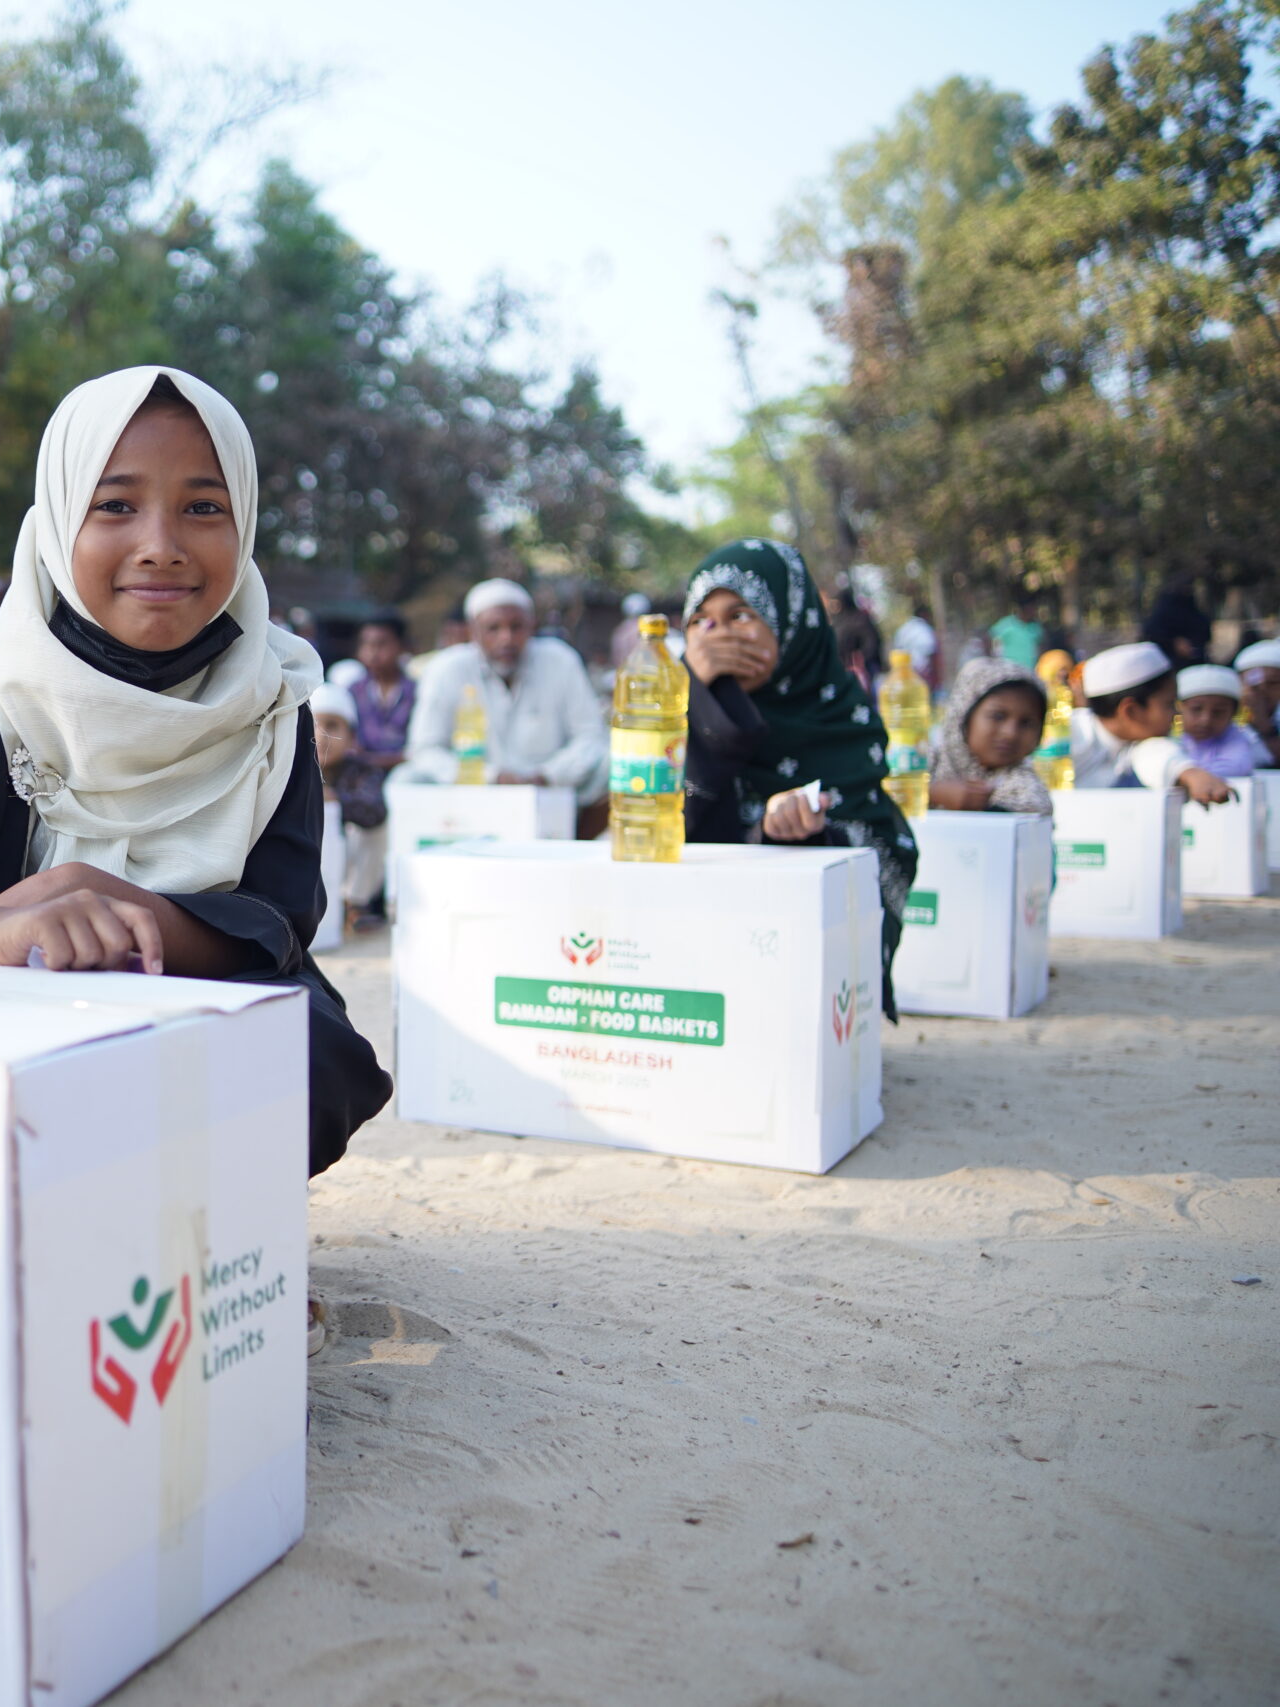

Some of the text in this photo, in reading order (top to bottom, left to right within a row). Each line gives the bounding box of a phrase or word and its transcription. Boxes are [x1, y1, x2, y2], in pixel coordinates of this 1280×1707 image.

[547, 985, 665, 1012] ORPHAN CARE
[499, 1002, 578, 1025] RAMADAN
[590, 1010, 635, 1031] FOOD
[639, 1015, 719, 1040] BASKETS
[537, 1042, 673, 1070] BANGLADESH
[200, 1247, 264, 1296] Mercy
[201, 1272, 286, 1336] Without
[202, 1329, 265, 1383] Limits
